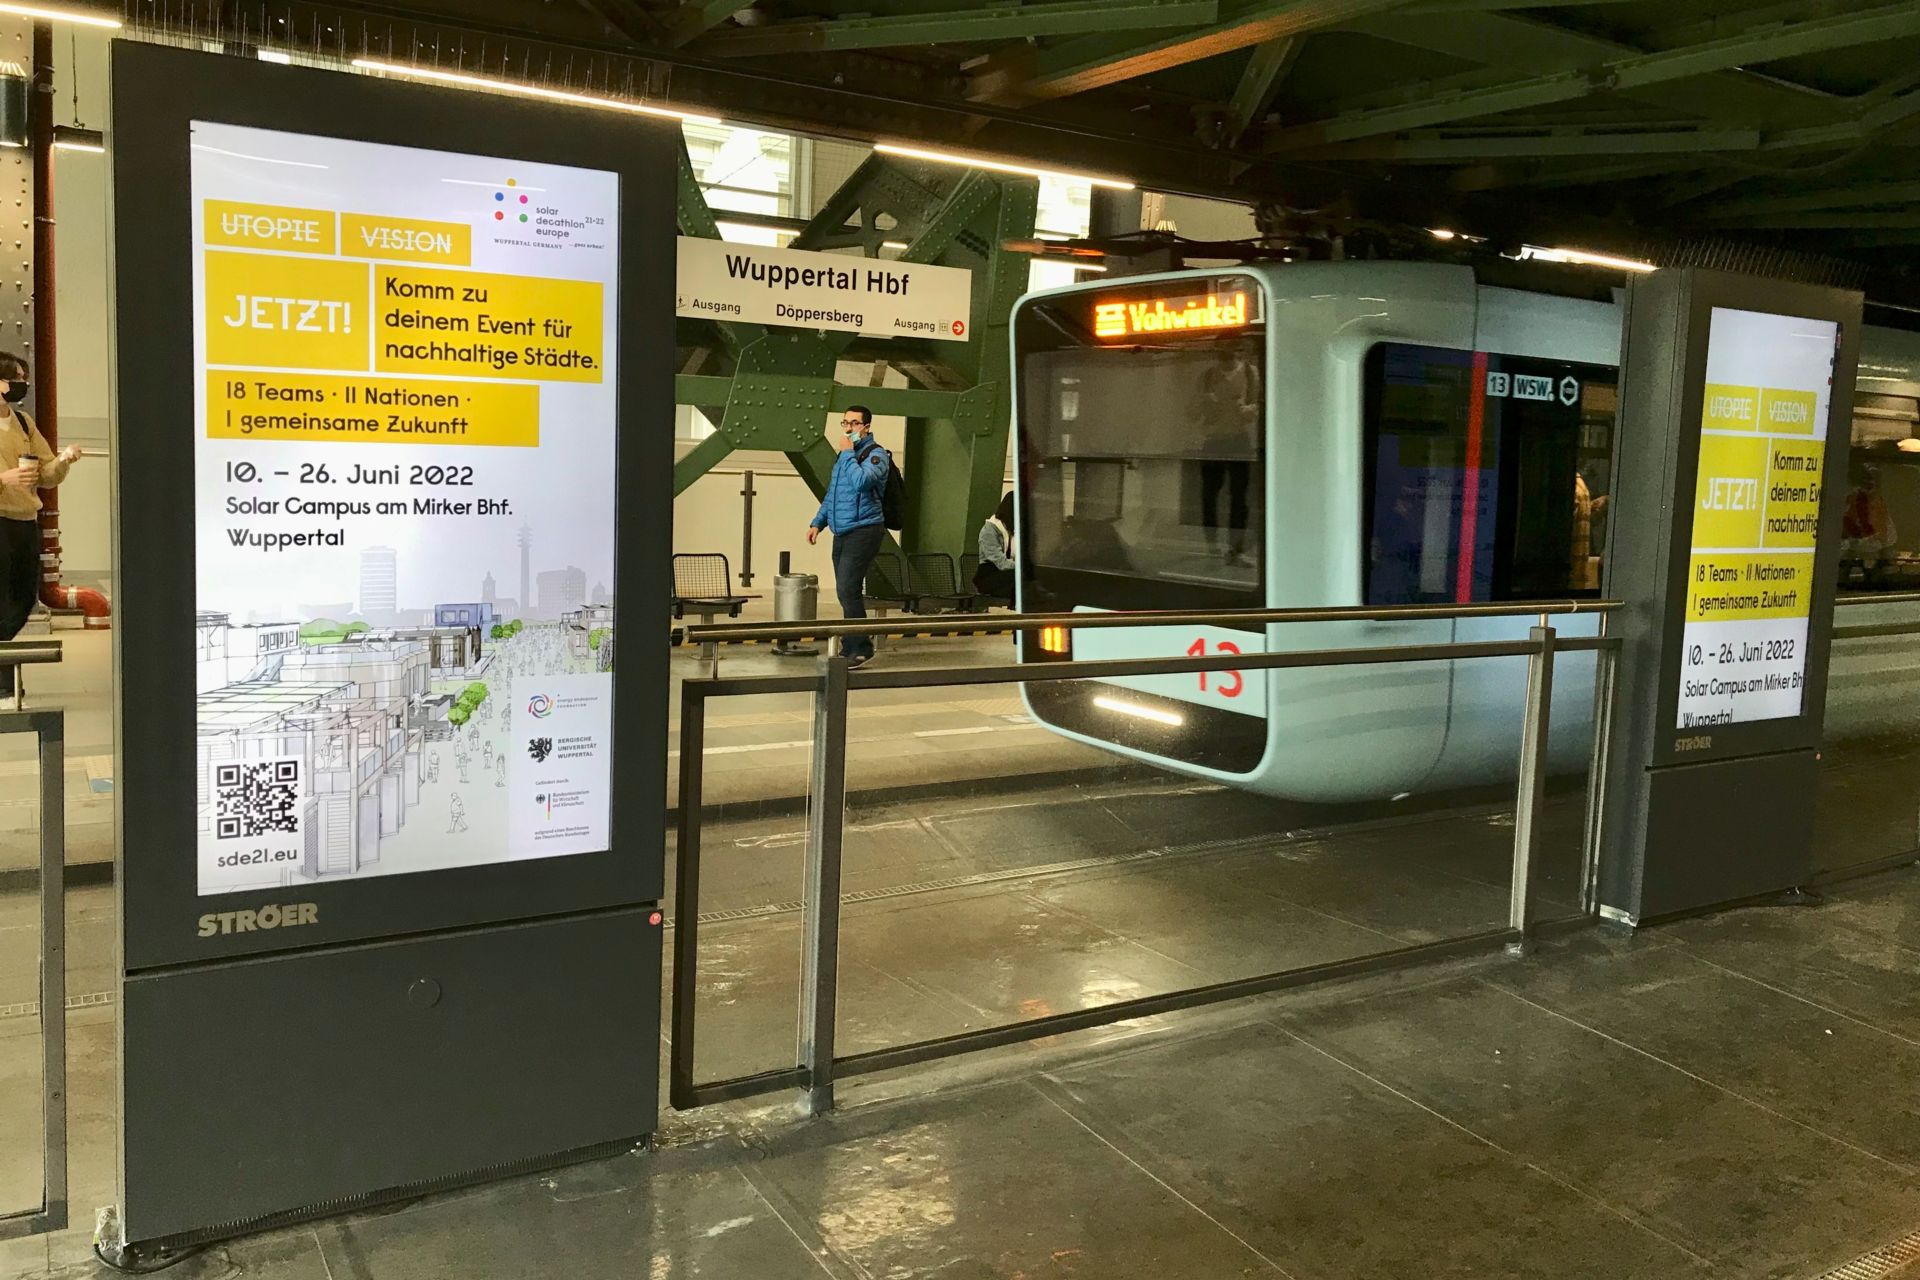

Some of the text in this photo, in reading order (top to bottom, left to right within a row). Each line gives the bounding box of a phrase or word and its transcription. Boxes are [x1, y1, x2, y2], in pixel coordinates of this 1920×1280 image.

[535, 216, 585, 229] decathlon
[536, 206, 559, 216] solar
[220, 211, 320, 243] UTOPIE
[535, 228, 570, 239] europe
[360, 225, 452, 254] VISION
[493, 238, 563, 250] WUPPERTAL GERMANY
[725, 254, 910, 296] Wuppertal Hbf
[385, 276, 488, 303] Komm zu
[223, 294, 351, 334] JETZT!
[691, 298, 741, 316] Ausgang
[775, 303, 864, 327] Döppersberg
[1128, 292, 1246, 332] Vohwinkel
[384, 308, 573, 339] deinem Event für
[893, 317, 936, 333] Ausgang
[385, 341, 599, 370] nachhaltige Städte.
[254, 382, 325, 403] Teams
[365, 387, 460, 408] Nationen
[1489, 375, 1506, 394] 13
[1709, 396, 1753, 420] UTOPIE
[1768, 400, 1808, 423] VISION
[240, 412, 380, 434] gemeinsame
[386, 415, 469, 435] Zukunft
[1773, 450, 1818, 472] Komm zu
[226, 461, 263, 483] 10.
[299, 462, 337, 484] 26.
[346, 463, 400, 485] Juni
[409, 465, 474, 486] 2022
[1701, 477, 1758, 511] JETZT!
[1770, 482, 1807, 502] deinem
[226, 496, 513, 520] Solar Campus am Mirker Bhf.
[227, 528, 344, 552] Wuppertal
[1708, 563, 1738, 582] Teams
[1754, 562, 1796, 581] Nationen
[1698, 592, 1759, 617] gemeinsame
[1760, 590, 1797, 609] Zukunft
[1718, 643, 1735, 664] 26.
[1738, 641, 1764, 663] Juni
[1765, 638, 1795, 661] 2022
[1187, 638, 1243, 698] 13
[1684, 679, 1709, 698] Solar
[1709, 677, 1747, 699] Campus
[1748, 678, 1763, 693] am
[1763, 673, 1791, 692] Mirker
[557, 735, 593, 745] BERGISCHE
[557, 742, 598, 753] UNIVERSITÄT
[557, 750, 594, 760] WUPPERTAL
[197, 902, 319, 938] STRÖER
